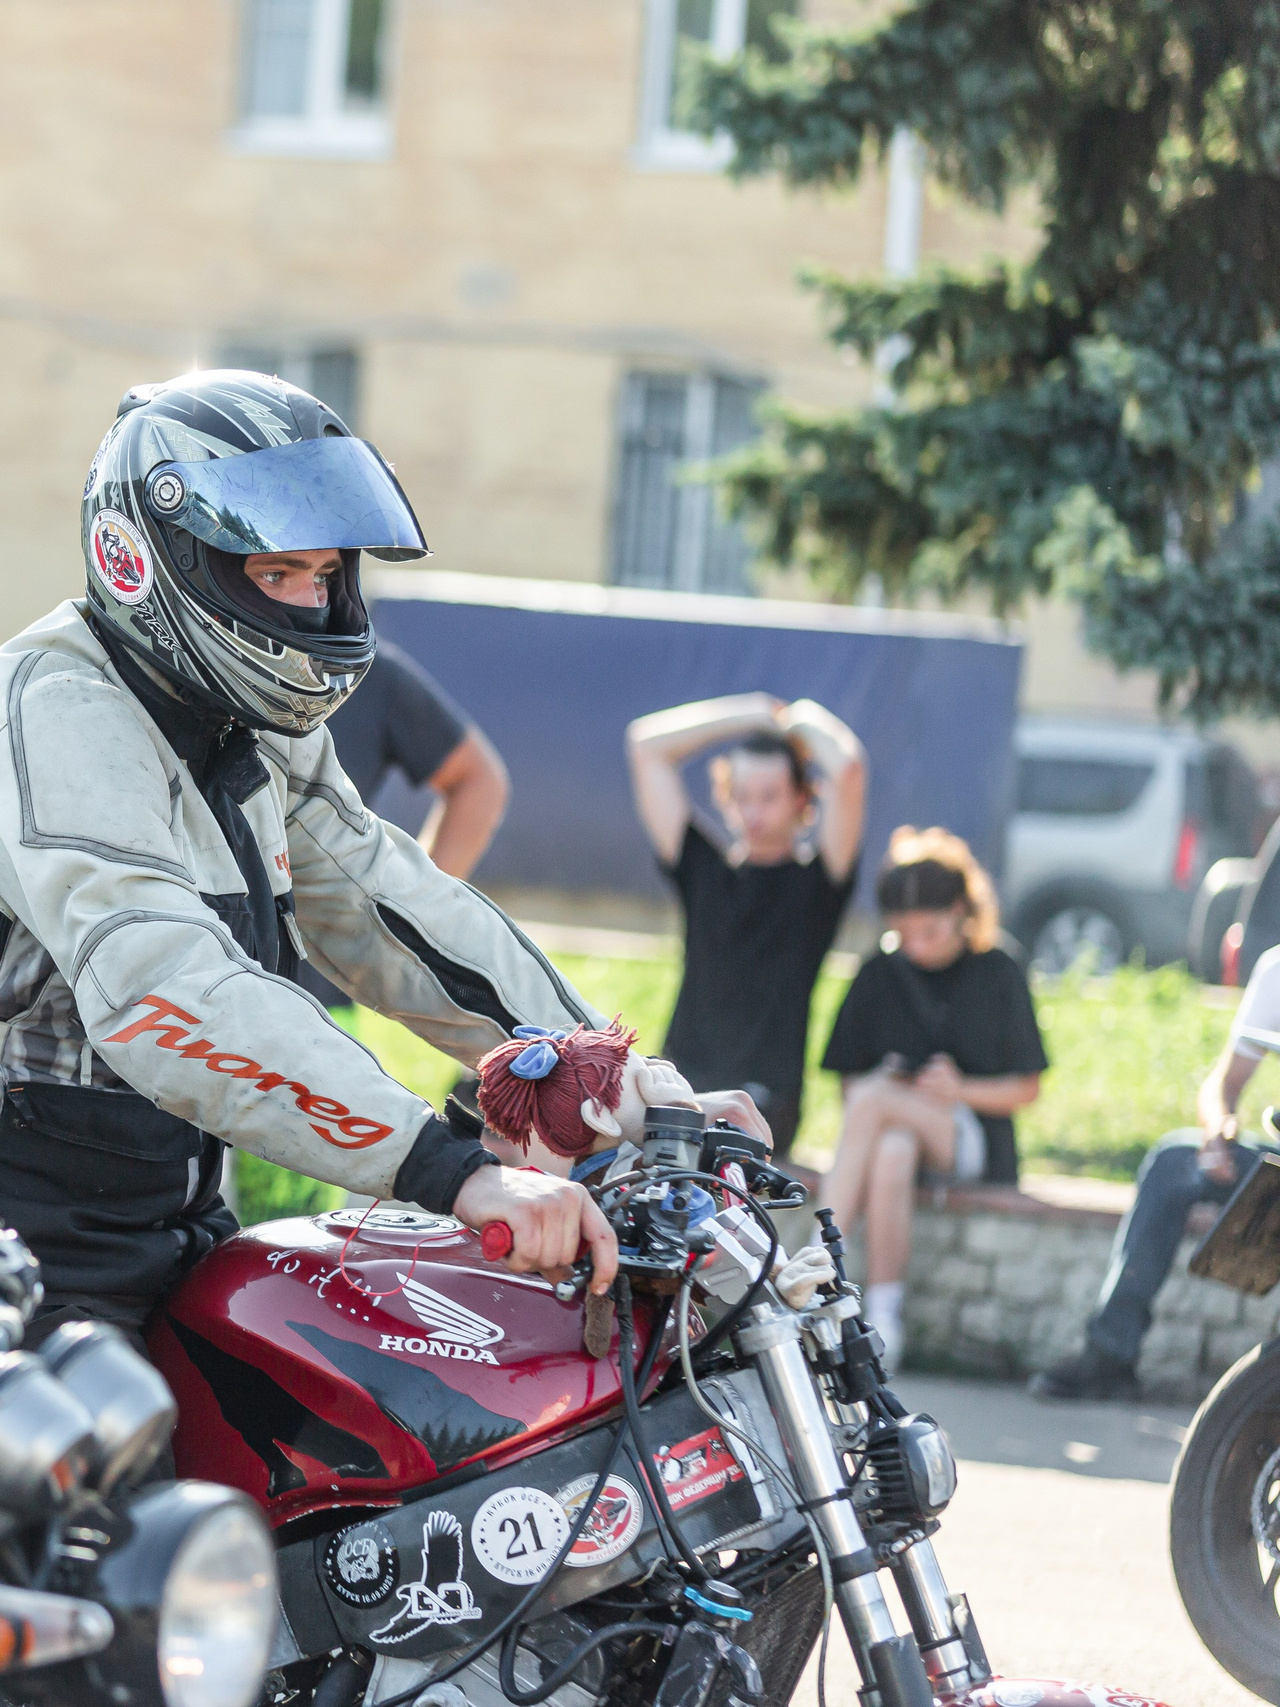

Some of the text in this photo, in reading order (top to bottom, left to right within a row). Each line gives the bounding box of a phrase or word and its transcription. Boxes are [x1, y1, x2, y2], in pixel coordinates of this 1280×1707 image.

[378, 1334, 501, 1366] HONDA
[344, 1538, 371, 1558] ОСБ
[498, 1511, 547, 1560] 21
[336, 1583, 361, 1604] КУРСК
